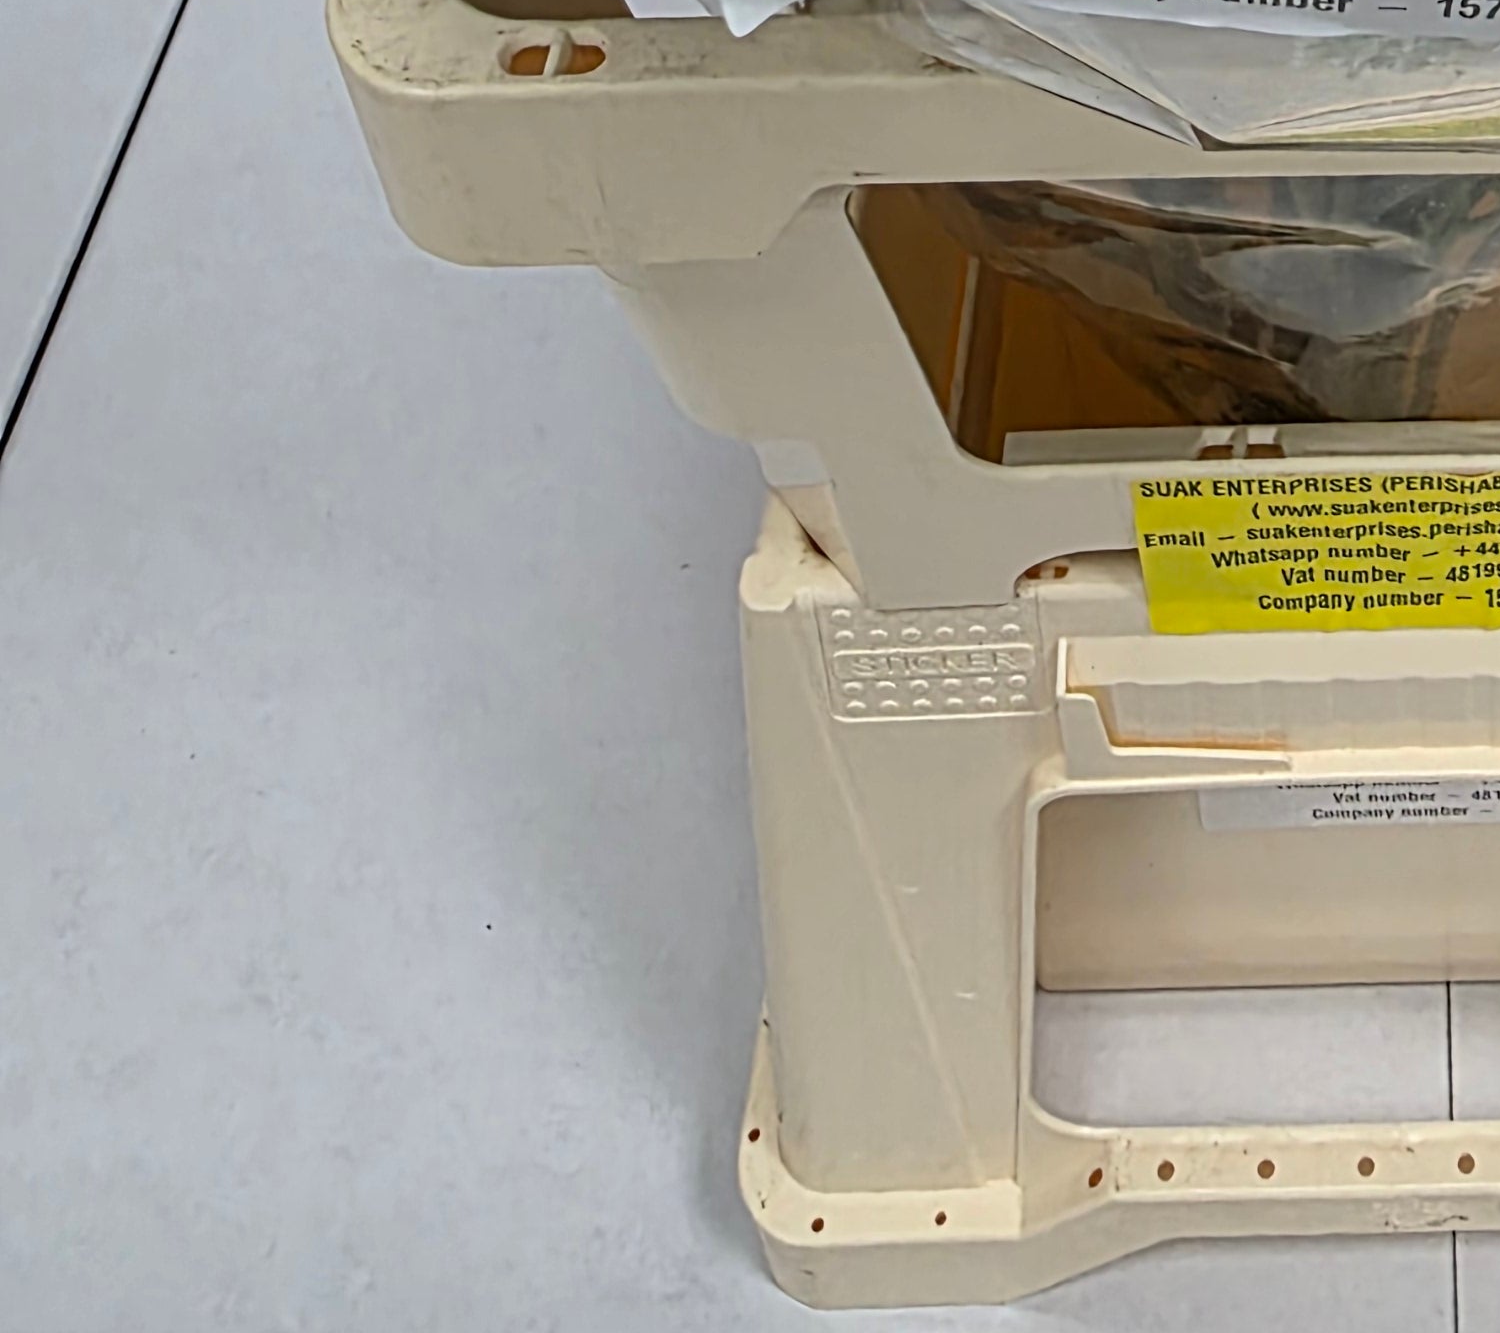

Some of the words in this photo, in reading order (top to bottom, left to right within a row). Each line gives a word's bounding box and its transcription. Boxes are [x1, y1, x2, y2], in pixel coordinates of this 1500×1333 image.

[1140, 480, 1203, 498] SUAK
[1212, 476, 1372, 496] ENTERPRISES
[1144, 532, 1205, 548] Email
[1211, 547, 1319, 568] Whatsapp
[1328, 544, 1411, 561] number
[1281, 568, 1315, 586] Vat
[1324, 566, 1406, 583] number
[1258, 592, 1355, 613] Company
[1363, 592, 1444, 608] number
[1333, 792, 1361, 804] Vat
[1368, 791, 1436, 802] number
[1312, 807, 1395, 820] Company
[1401, 806, 1468, 817] number
